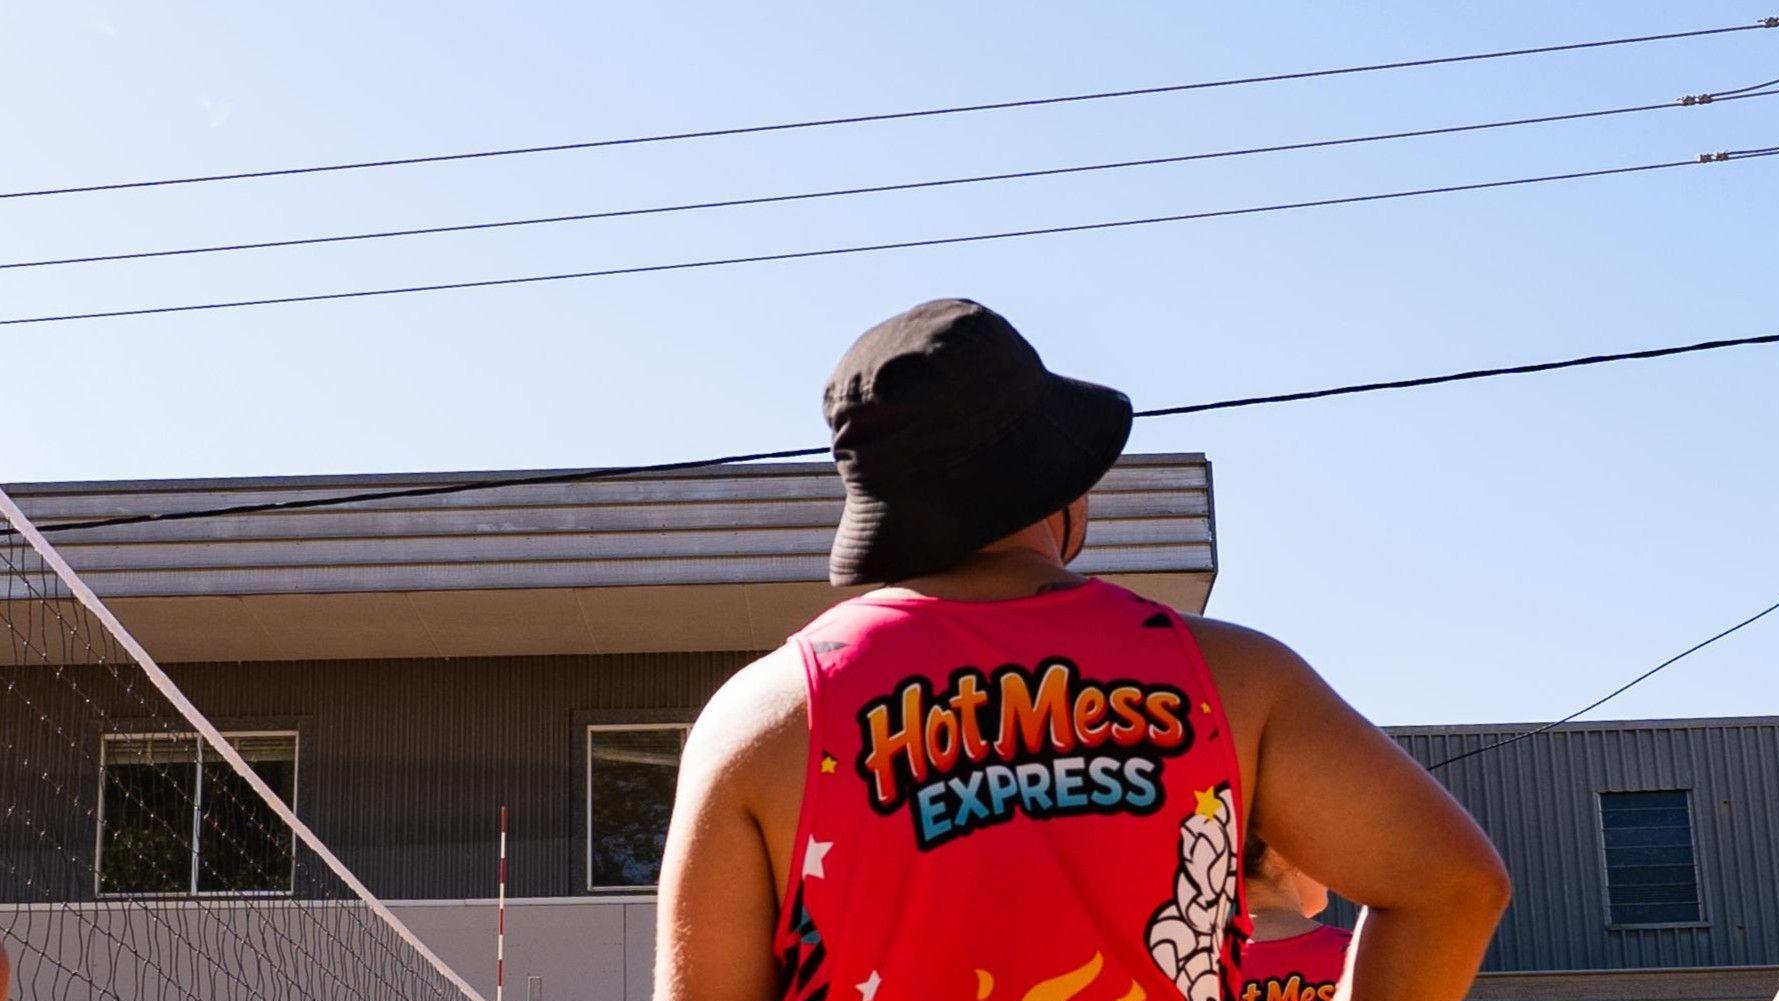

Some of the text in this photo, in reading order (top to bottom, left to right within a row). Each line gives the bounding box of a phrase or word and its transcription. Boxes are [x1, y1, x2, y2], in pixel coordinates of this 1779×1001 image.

[866, 664, 1183, 801] Hot Mess
[917, 757, 1157, 842] EXPRESS
